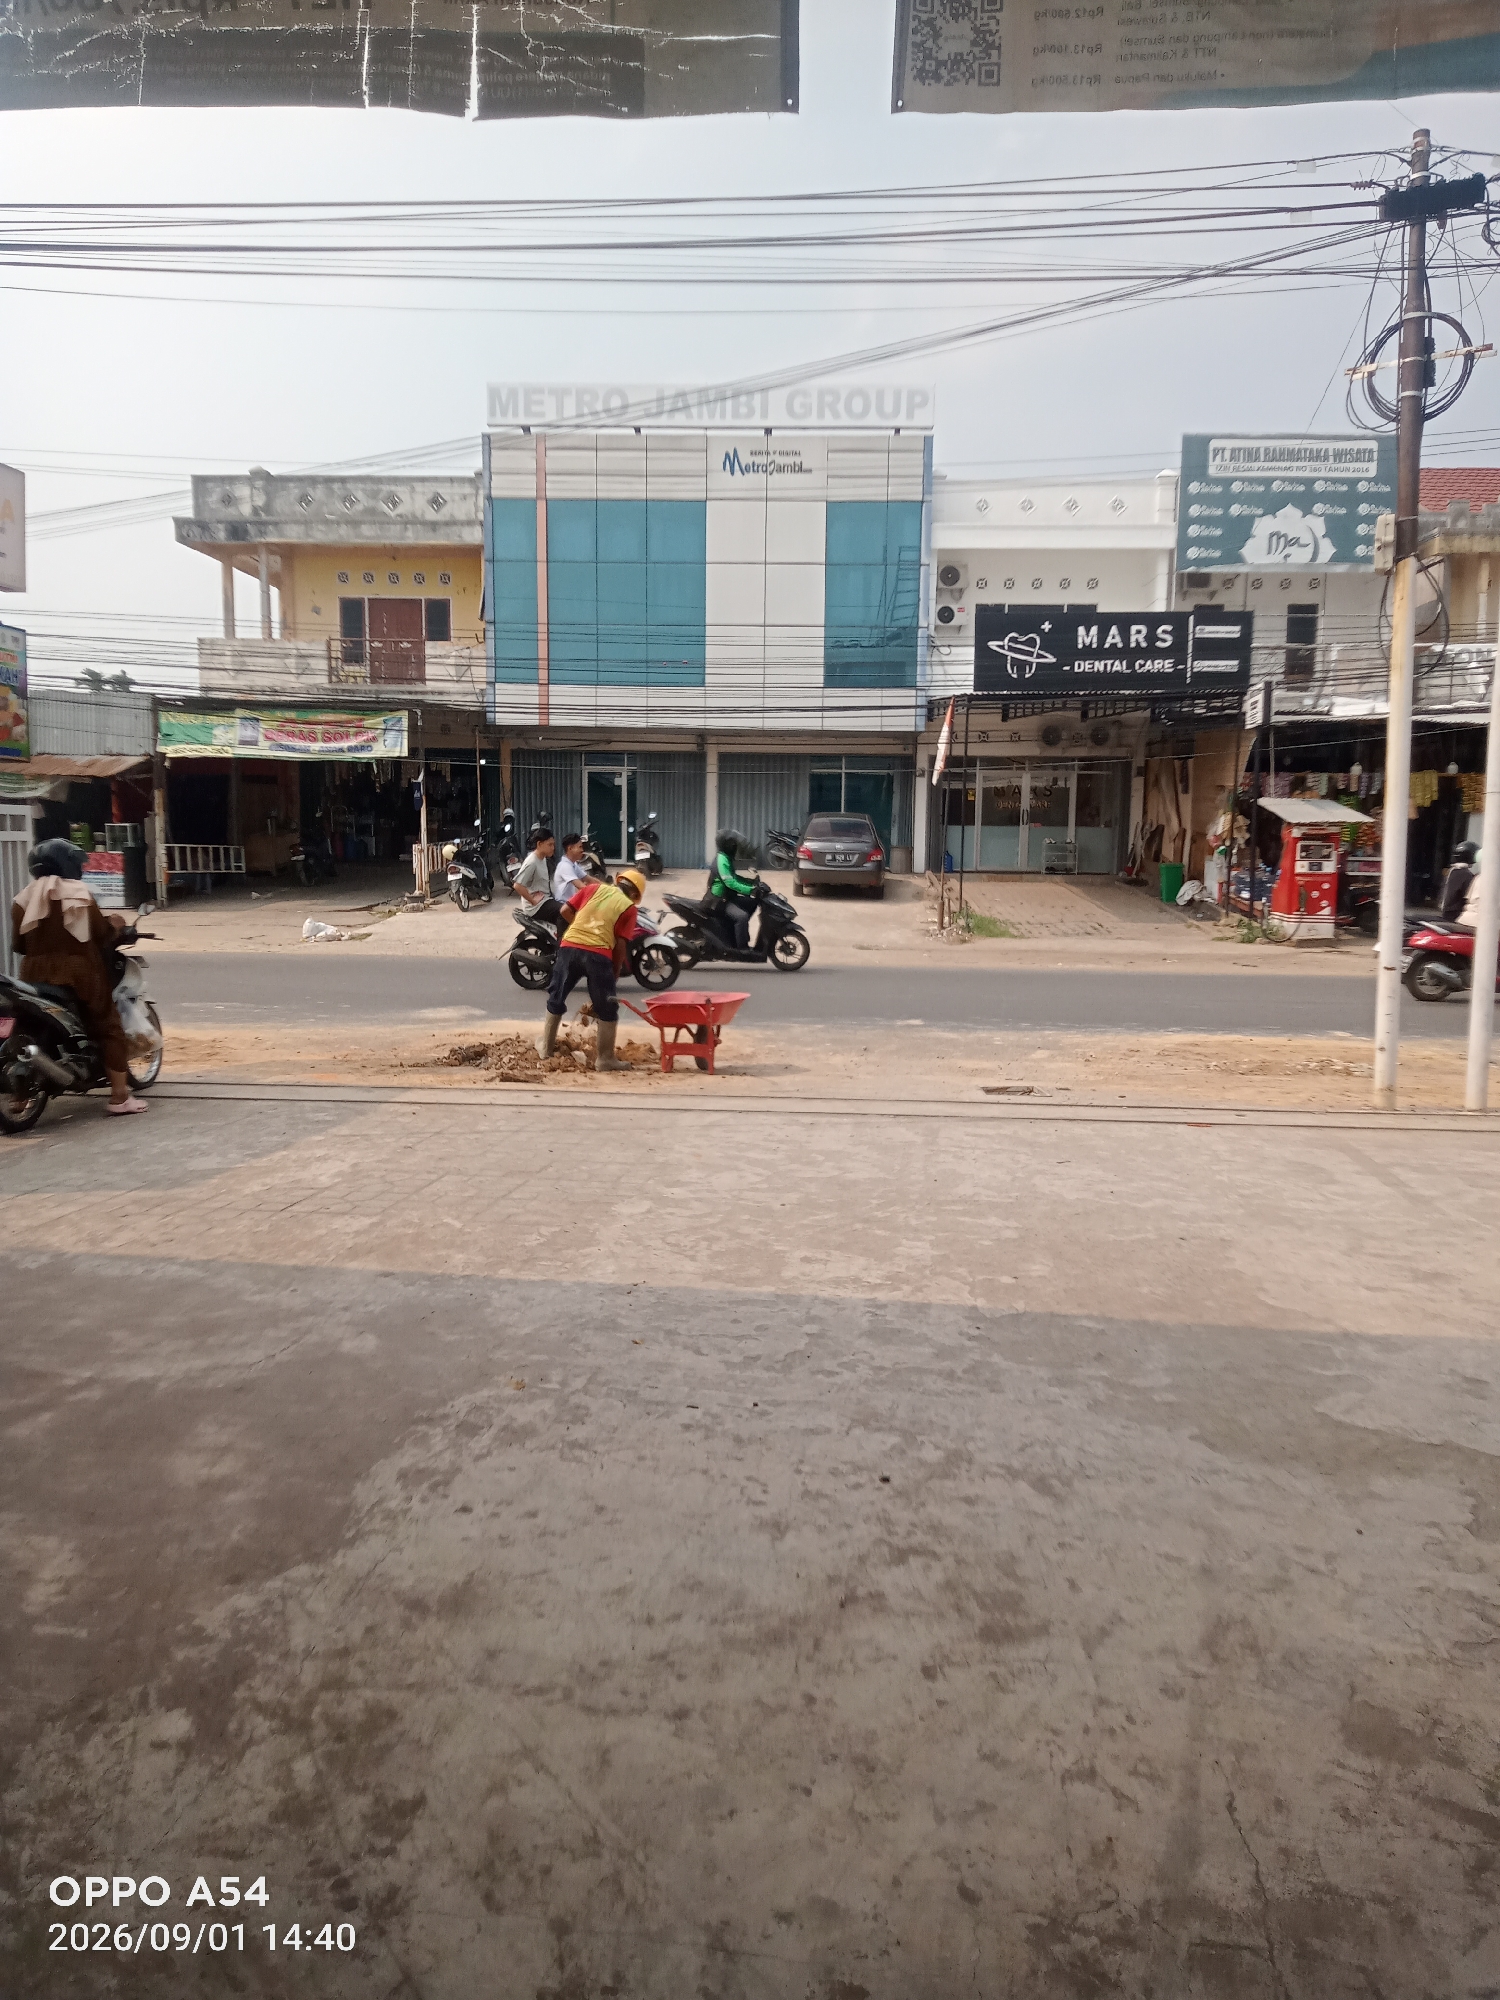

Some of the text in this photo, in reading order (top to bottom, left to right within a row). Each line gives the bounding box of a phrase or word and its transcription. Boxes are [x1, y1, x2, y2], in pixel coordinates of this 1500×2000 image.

[487, 387, 930, 421] METRO JAMBI GROUP
[1229, 447, 1261, 463] ATINA
[1333, 447, 1375, 464] WISATA
[1324, 465, 1350, 474] TAHUN
[1351, 466, 1370, 474] 2016
[1076, 624, 1174, 650] MARS
[1074, 659, 1132, 674] DENTAL
[1134, 658, 1176, 674] CARE
